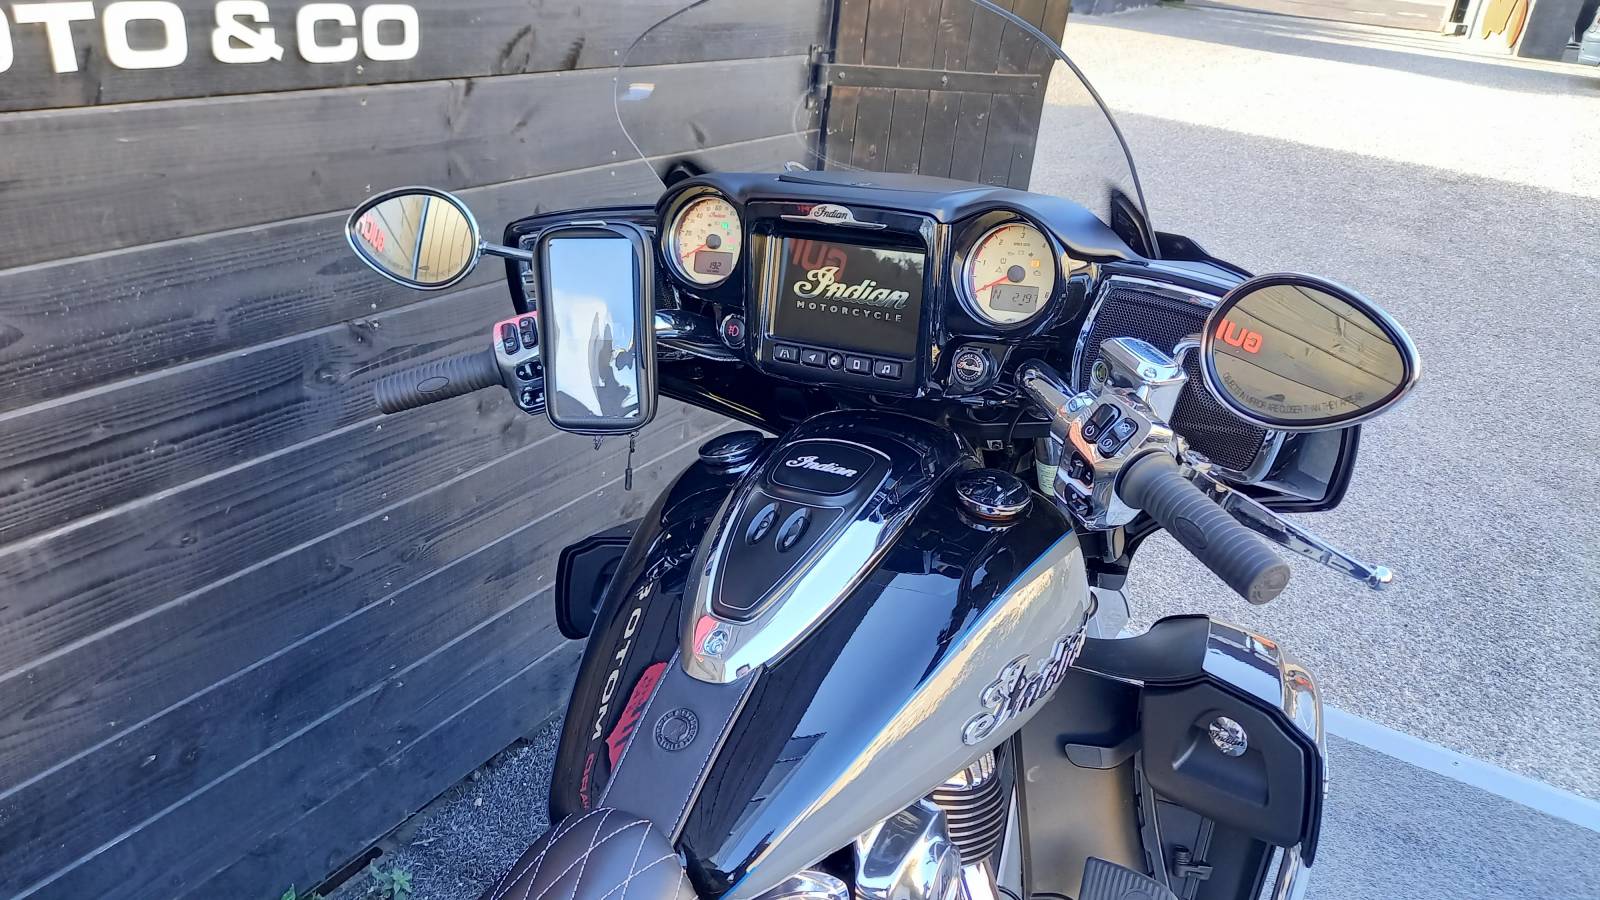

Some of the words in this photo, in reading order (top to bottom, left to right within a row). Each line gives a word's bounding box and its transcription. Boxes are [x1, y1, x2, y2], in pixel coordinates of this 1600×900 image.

[0, 0, 190, 73] TO
[212, 0, 285, 64] &
[297, 2, 420, 64] CO
[814, 206, 848, 220] Indian
[793, 266, 910, 310] Indian
[796, 301, 903, 322] MOTORCYCLE
[785, 456, 858, 477] Indian
